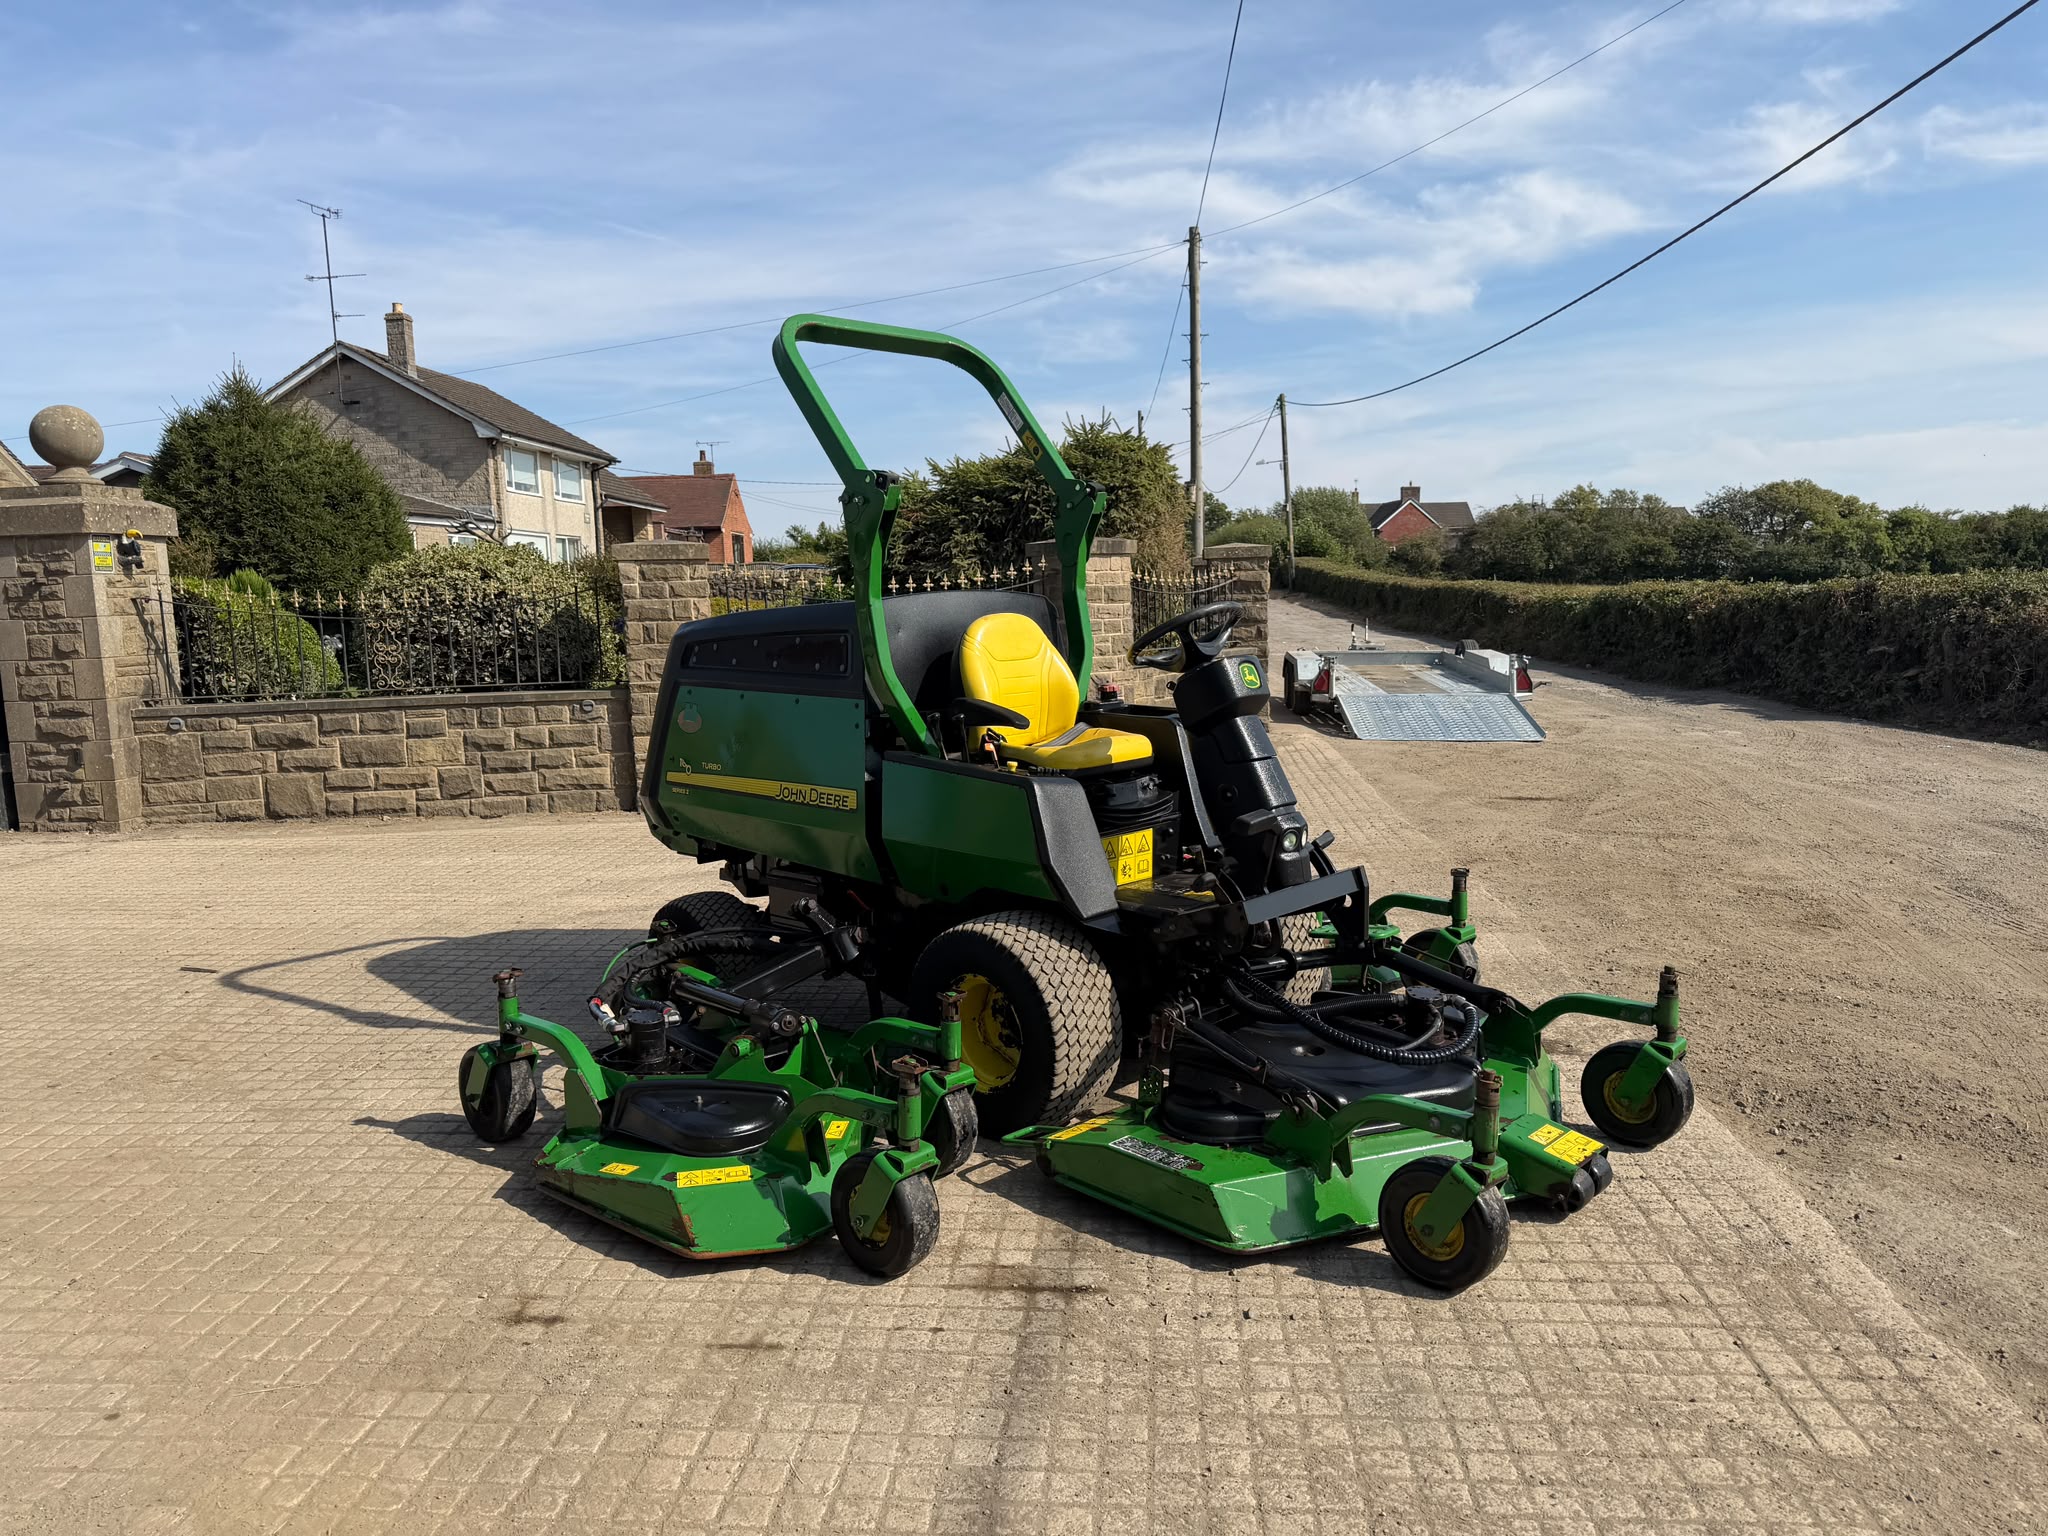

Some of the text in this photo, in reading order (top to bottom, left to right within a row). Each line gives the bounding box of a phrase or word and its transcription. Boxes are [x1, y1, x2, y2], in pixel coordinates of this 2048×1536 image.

[702, 762, 721, 771] TURBO
[775, 783, 850, 808] JOHN DEERE
